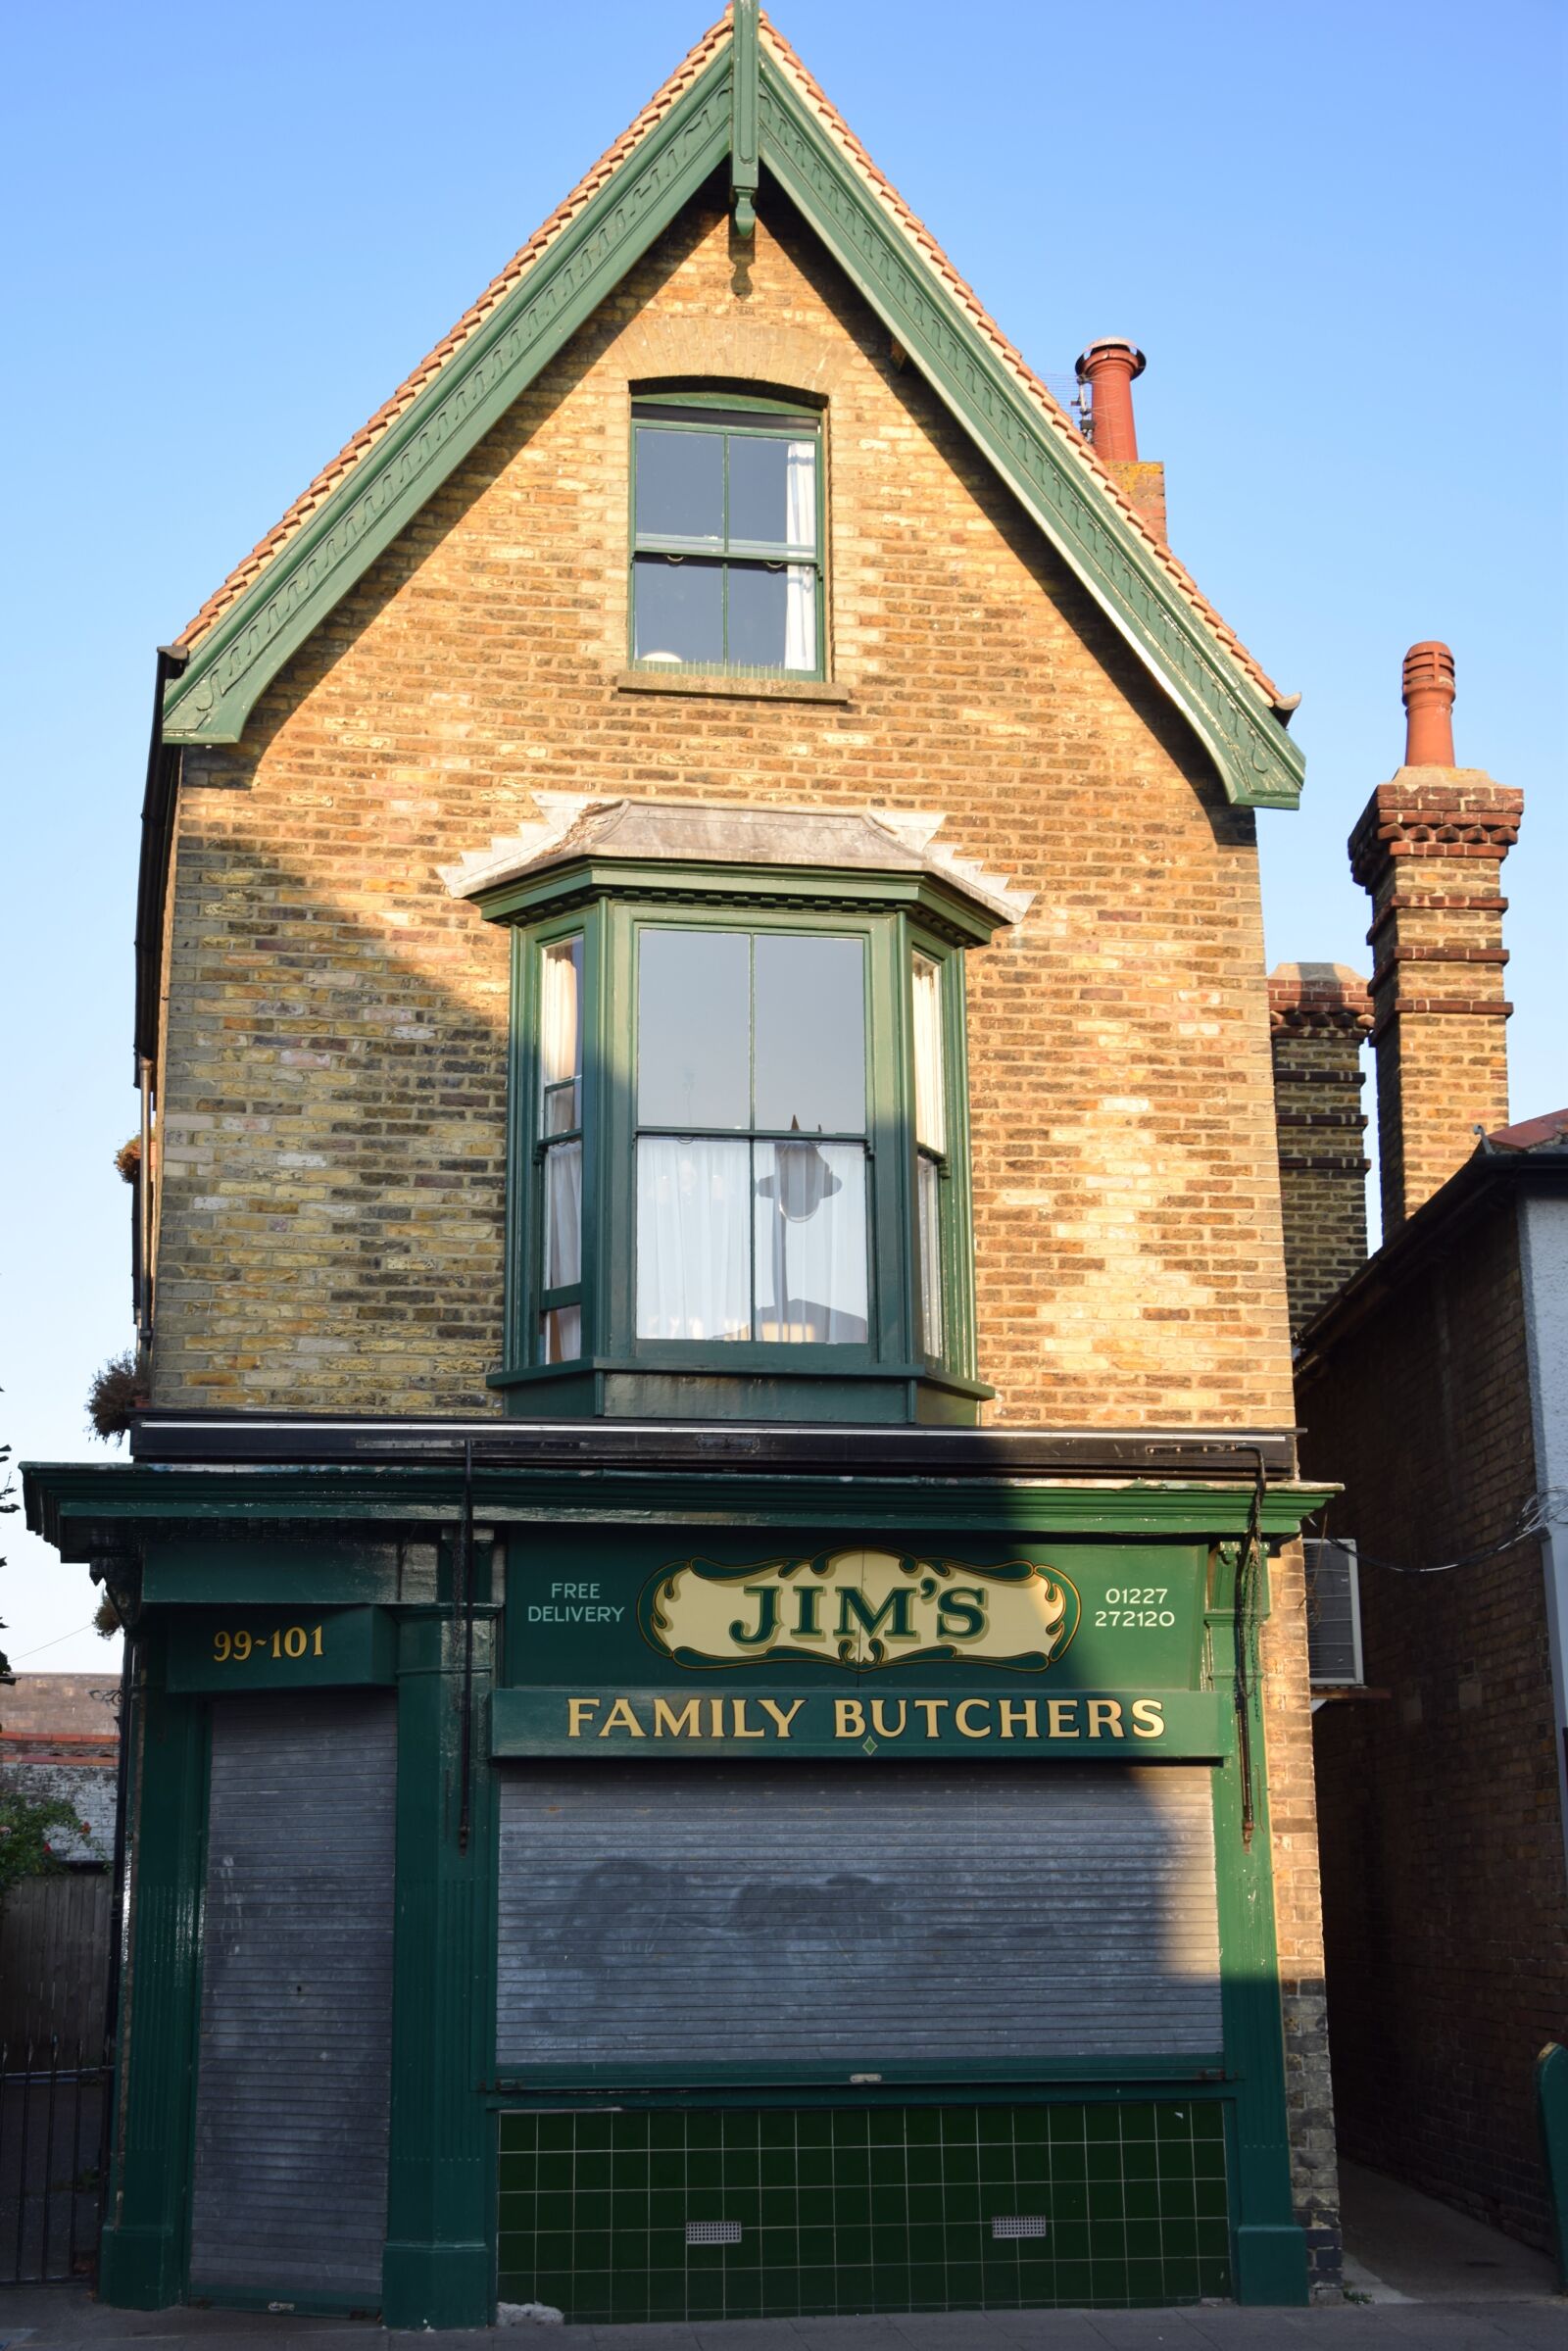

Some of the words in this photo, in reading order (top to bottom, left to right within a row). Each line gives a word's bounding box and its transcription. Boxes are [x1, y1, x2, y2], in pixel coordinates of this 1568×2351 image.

[552, 1583, 601, 1598] FREE
[1105, 1588, 1169, 1605] 01227
[527, 1605, 625, 1623] DELIVERY
[729, 1578, 987, 1644] JIM'S
[1095, 1611, 1176, 1628] 272120
[567, 1698, 806, 1739] FAMILY
[834, 1698, 1167, 1739] BUTCHERS
